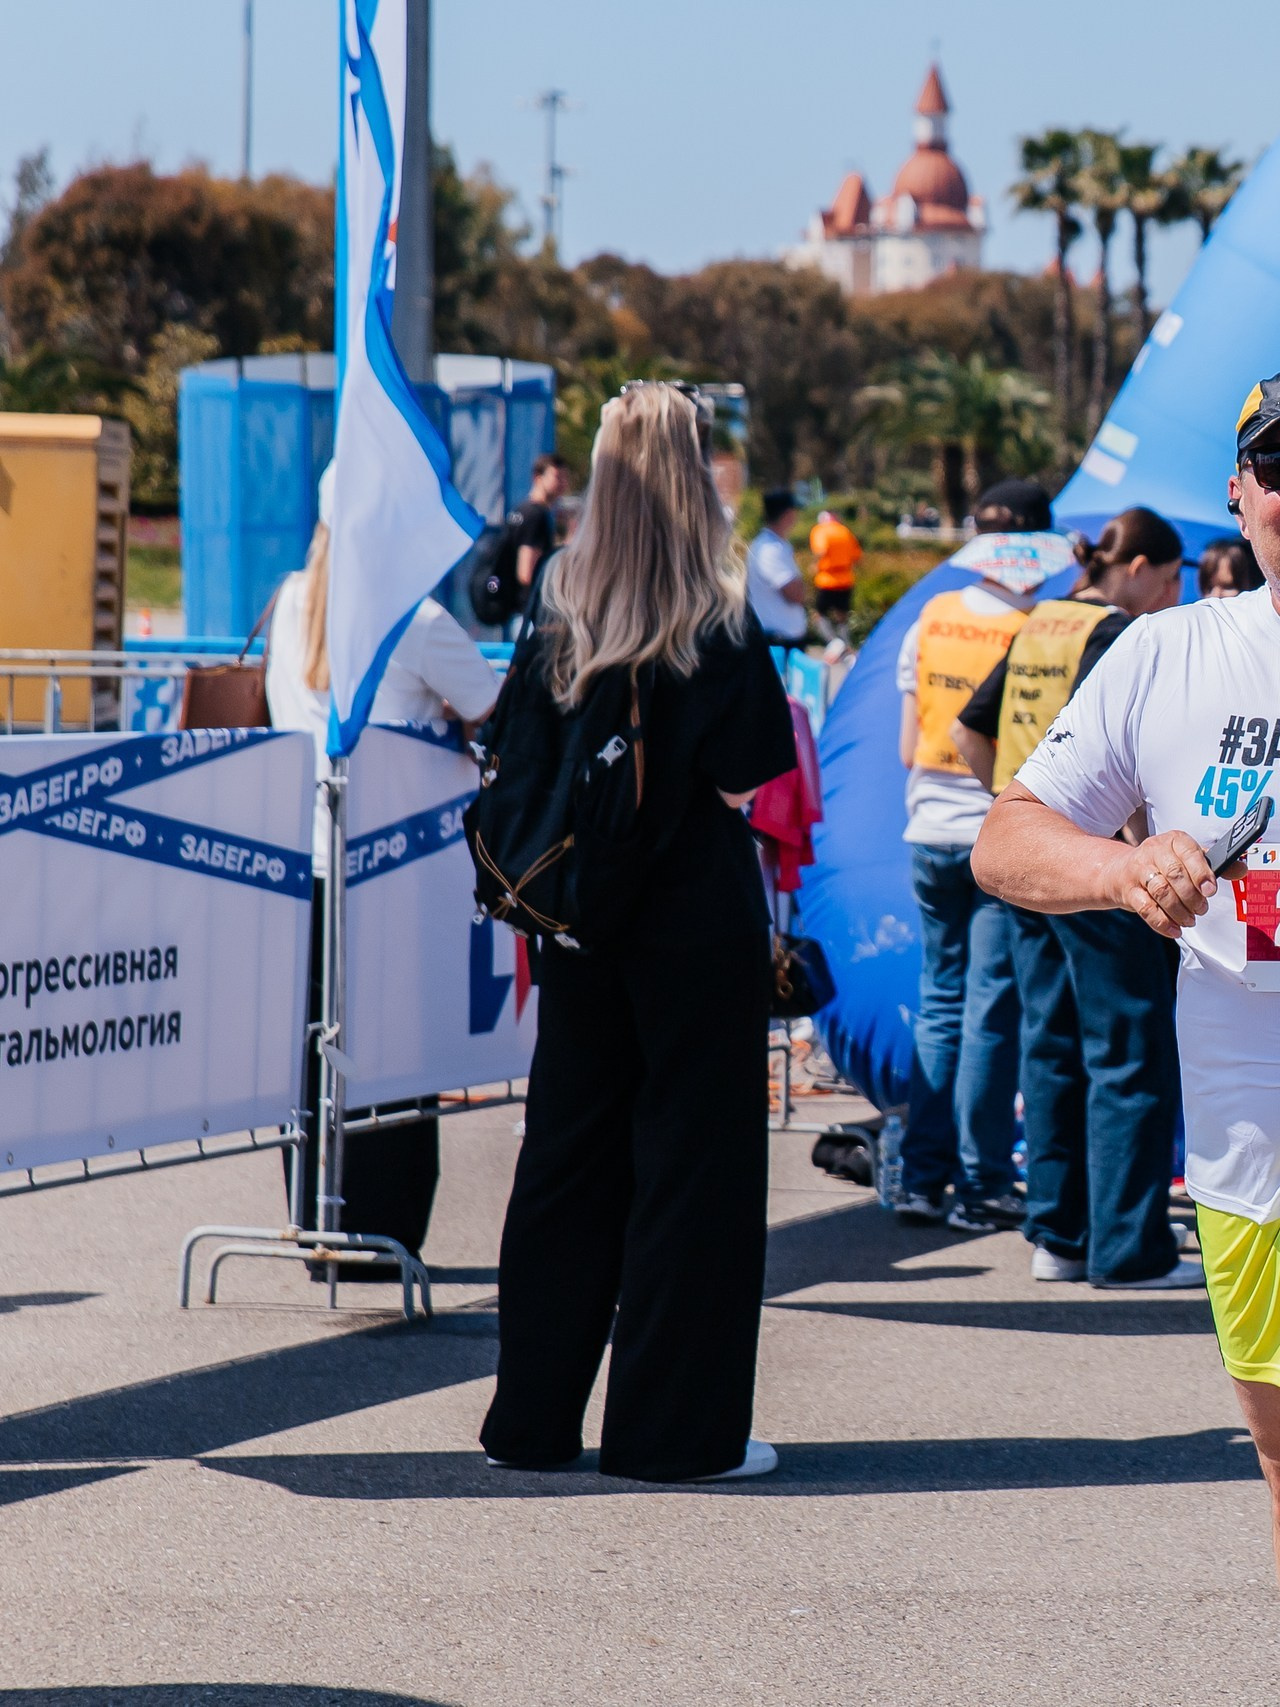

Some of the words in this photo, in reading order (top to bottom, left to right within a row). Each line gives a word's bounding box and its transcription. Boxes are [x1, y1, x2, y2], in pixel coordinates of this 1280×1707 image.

[0, 756, 123, 826] ЗАБЕГ.РФ
[1194, 766, 1275, 819] 45%
[180, 833, 287, 882] ЗАБЕГ.РФ
